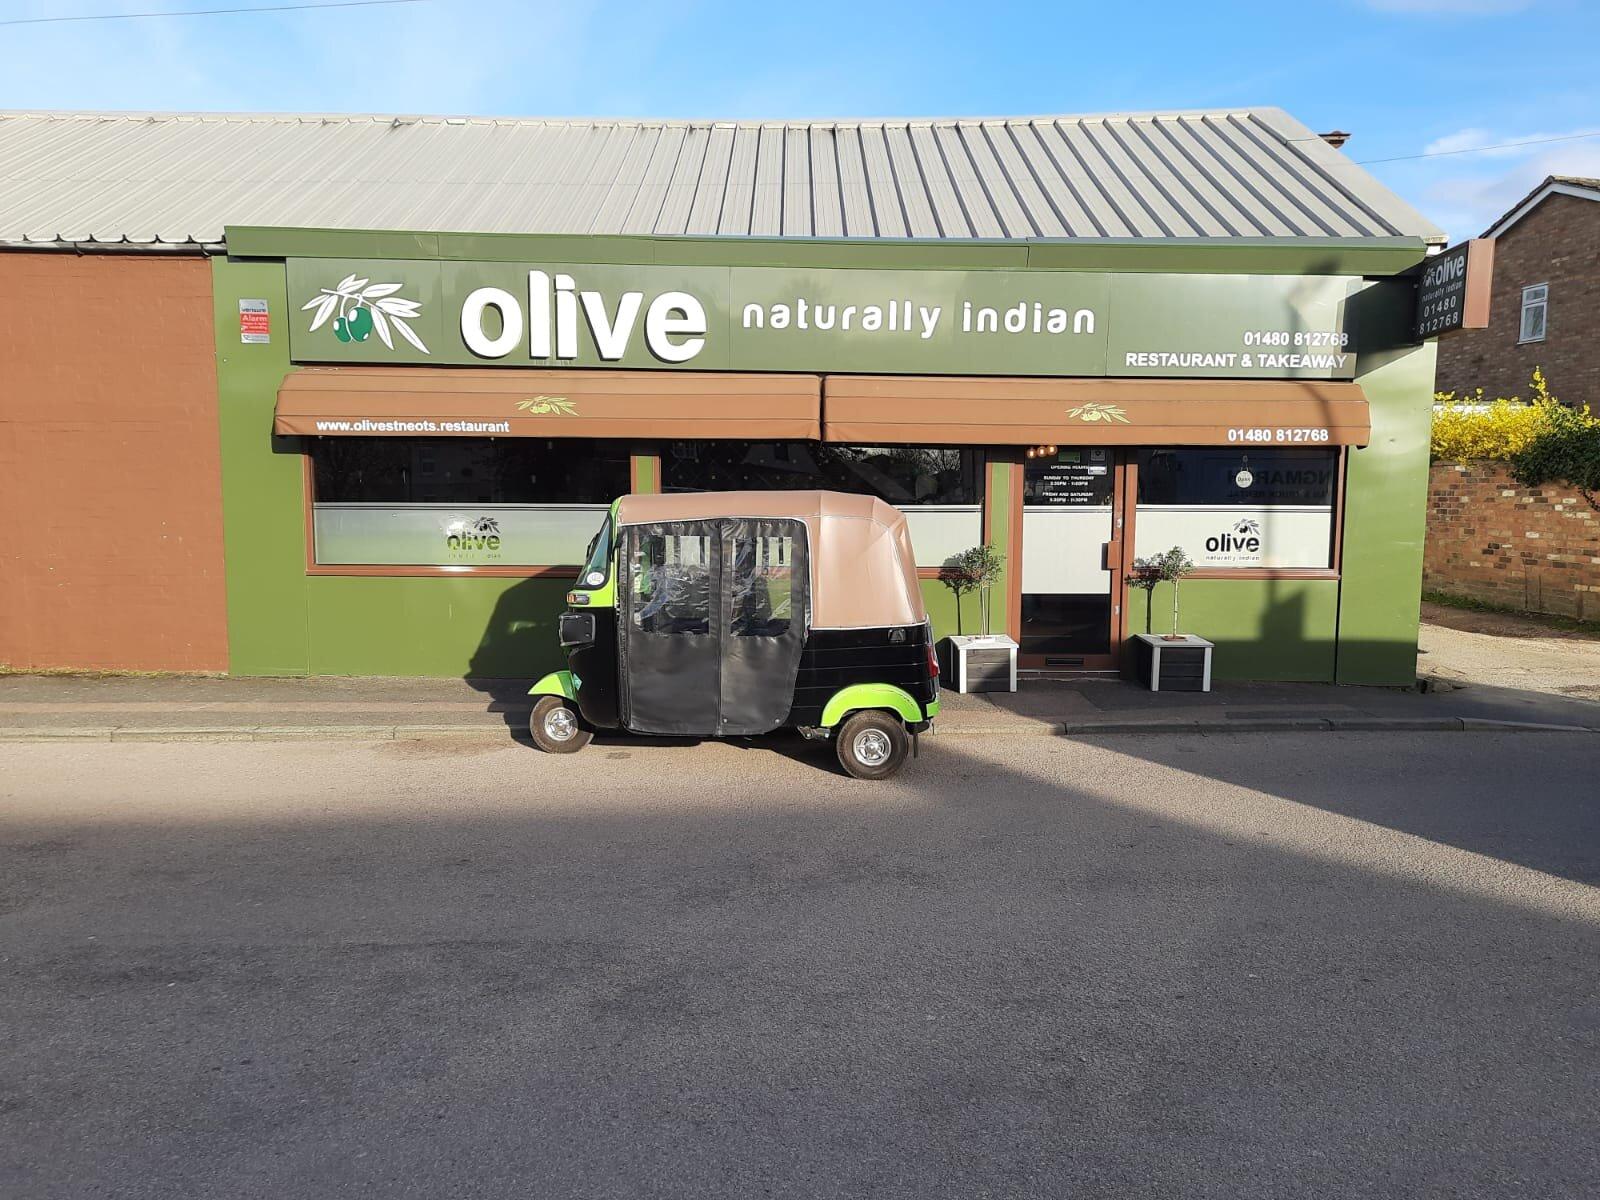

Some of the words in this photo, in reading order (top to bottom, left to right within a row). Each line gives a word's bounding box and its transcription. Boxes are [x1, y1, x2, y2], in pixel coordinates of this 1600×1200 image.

[1436, 255, 1464, 284] olive
[461, 270, 708, 363] olive
[1424, 296, 1457, 318] 01480
[242, 314, 267, 322] Alarm
[742, 298, 942, 339] naturally
[963, 301, 1096, 335] indian
[1419, 311, 1459, 335] 812768
[1244, 331, 1289, 346] 01480
[1294, 331, 1349, 347] 812768
[1125, 353, 1237, 367] RESTAURANT
[1241, 354, 1254, 368] &
[1257, 354, 1348, 369] TAKEAWAY
[316, 419, 510, 434] www.olivestneots.restaurant
[1228, 429, 1271, 442] 01480
[1276, 429, 1329, 443] 812768
[446, 531, 501, 551] olive
[1205, 533, 1260, 552] olive
